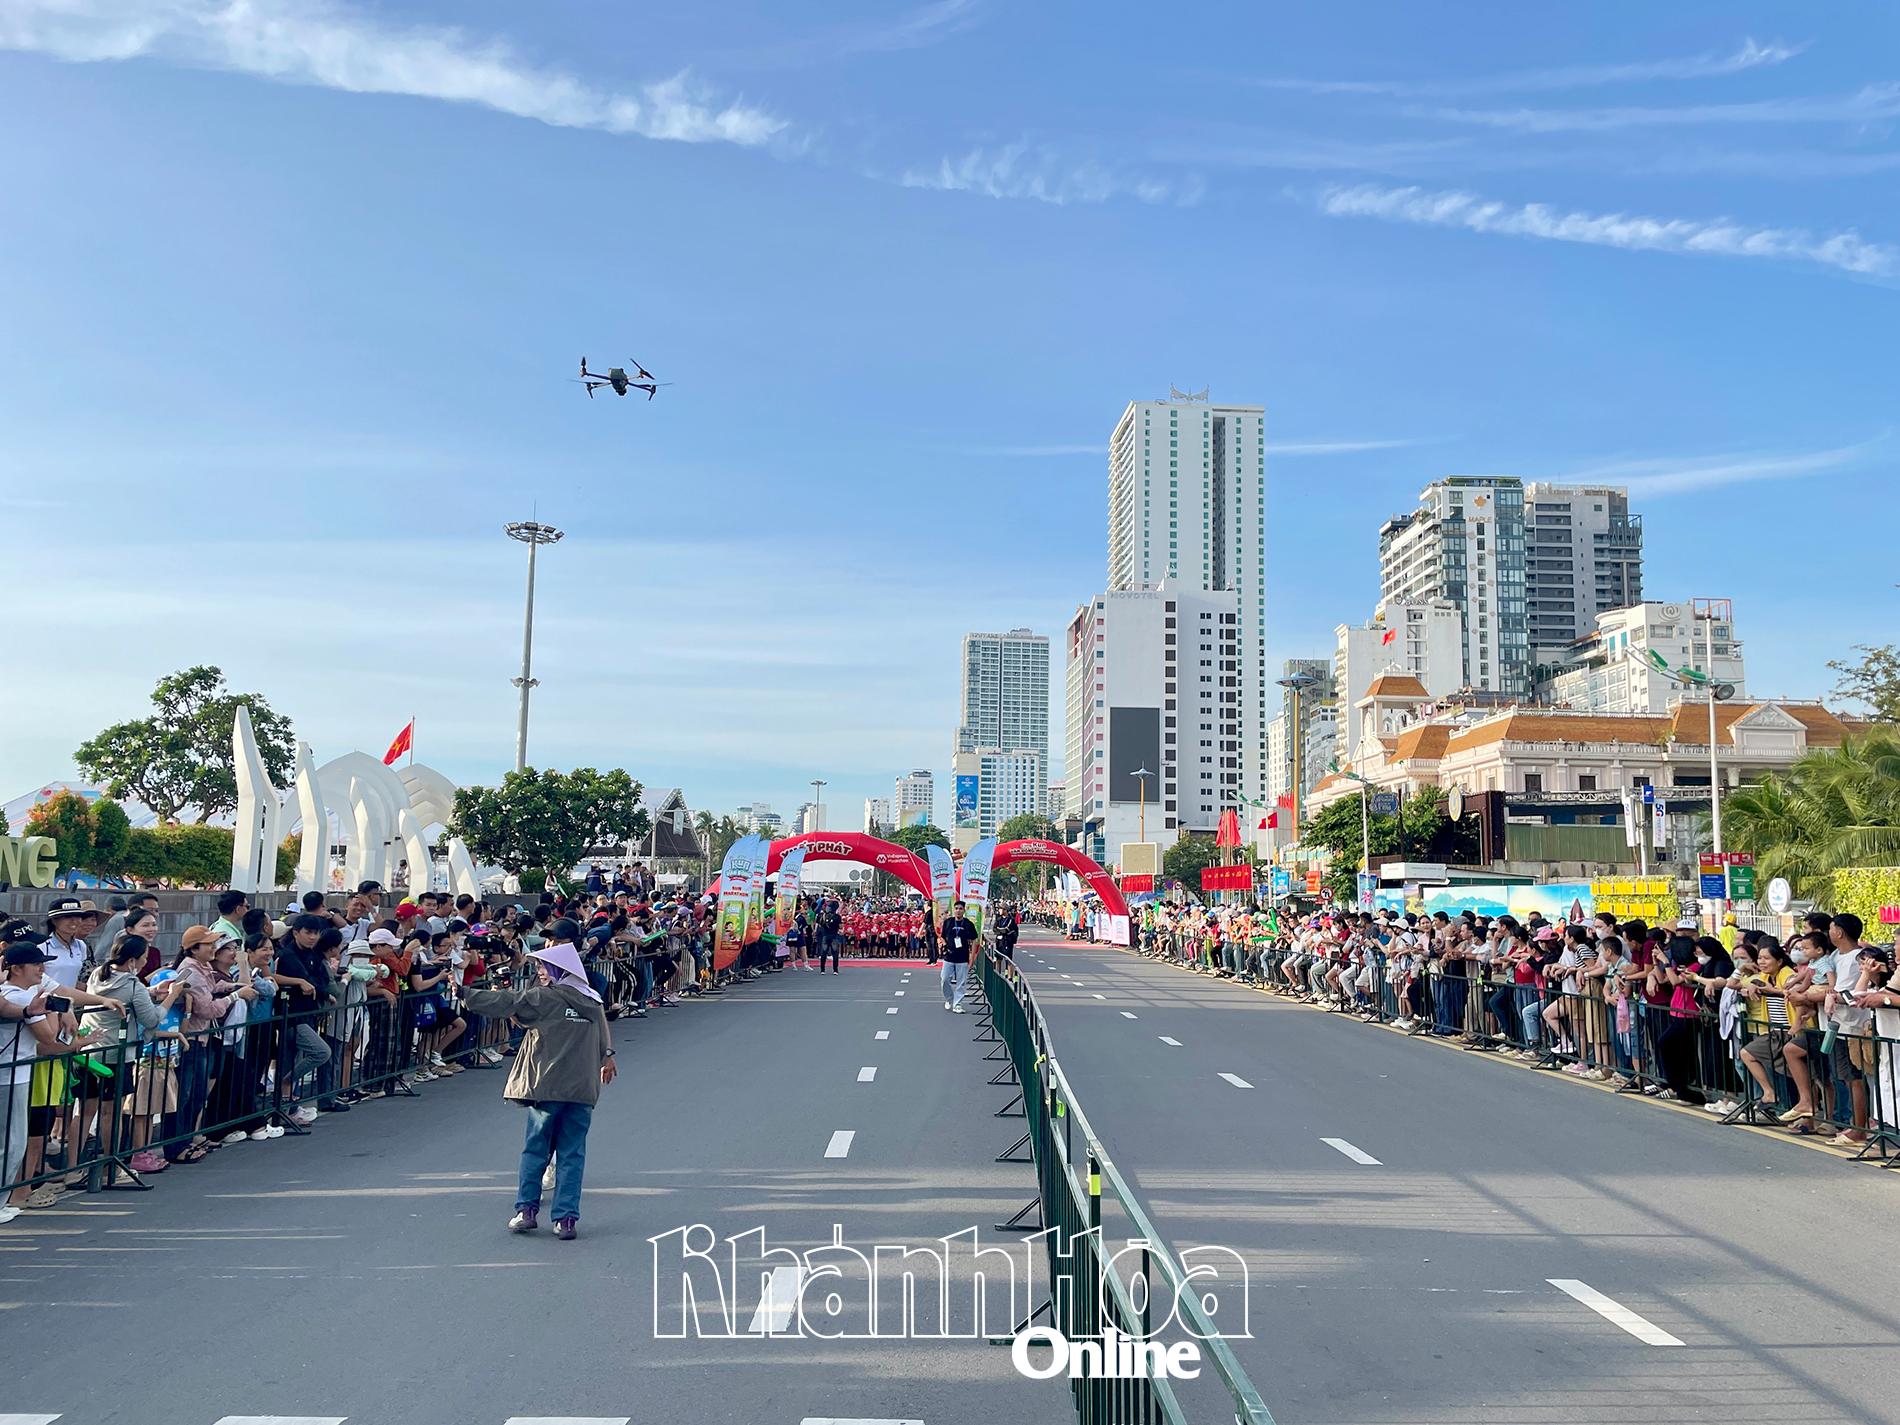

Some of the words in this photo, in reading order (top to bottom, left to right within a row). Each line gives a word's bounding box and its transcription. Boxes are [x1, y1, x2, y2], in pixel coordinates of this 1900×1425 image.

[1110, 591, 1160, 600] NOVOTEL
[1655, 803, 1665, 817] 5G
[817, 842, 853, 856] PHÁT
[0, 836, 60, 889] NG
